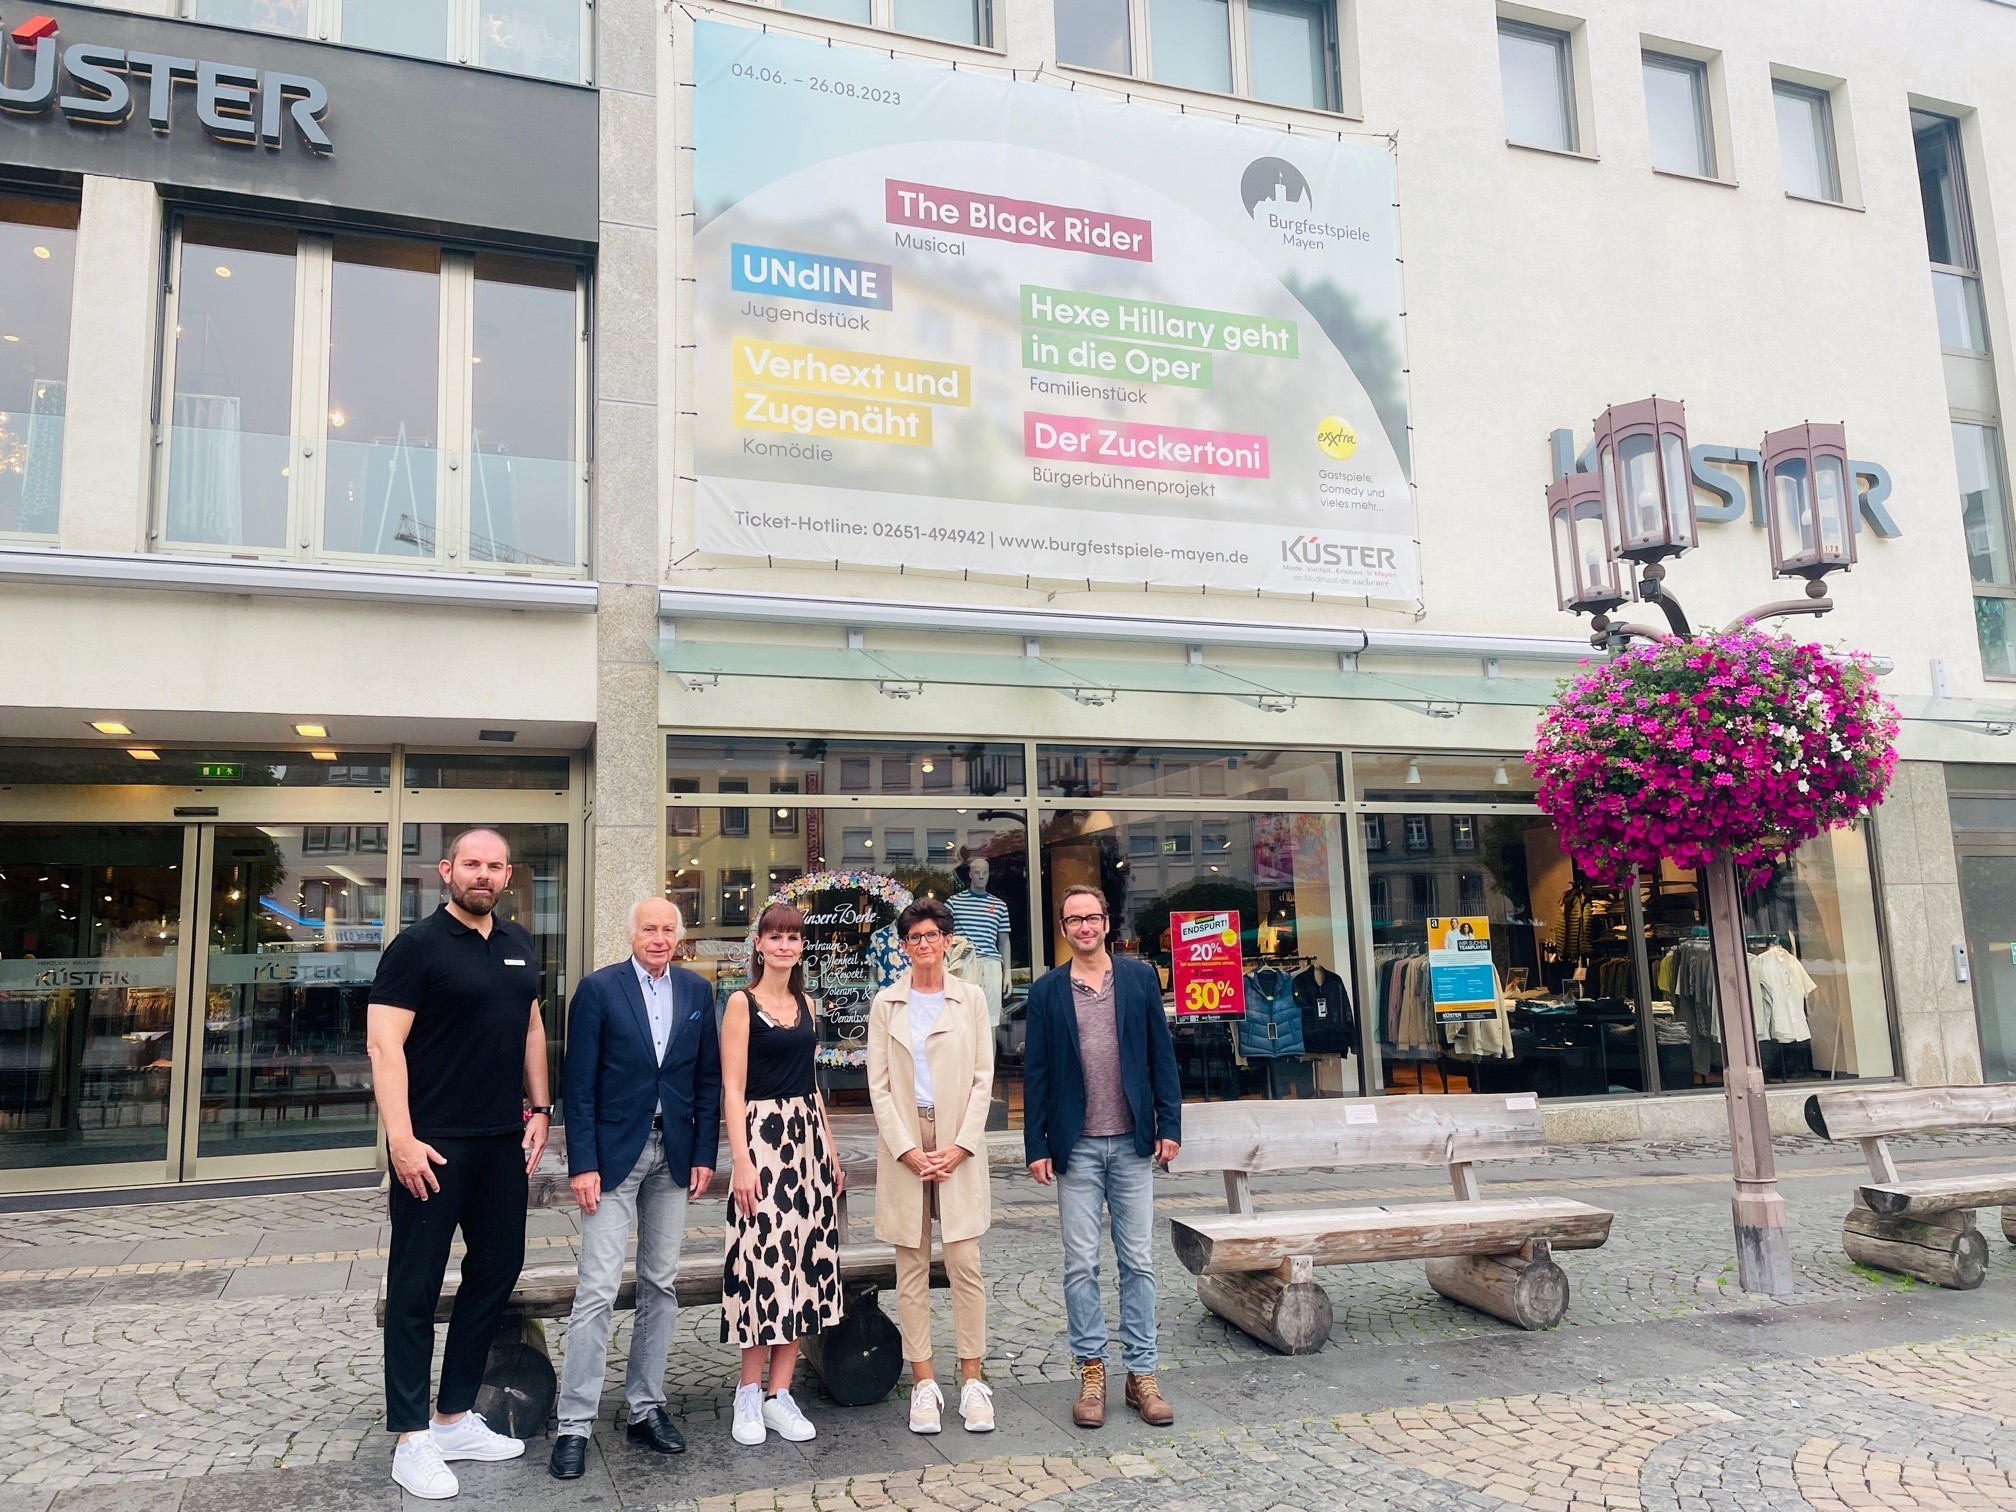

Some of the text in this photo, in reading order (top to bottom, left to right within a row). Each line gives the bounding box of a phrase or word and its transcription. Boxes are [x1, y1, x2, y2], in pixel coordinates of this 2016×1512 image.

[731, 63, 787, 85] 04.06.
[808, 76, 902, 106] 26.08.2023
[897, 190, 1144, 253] The Black Rider
[1268, 213, 1371, 242] Burgfestspiele
[894, 231, 965, 257] Musical
[1282, 233, 1325, 250] Mayen
[742, 253, 878, 300] UNdINE
[740, 300, 871, 332] Jugendstück
[1030, 292, 1290, 352] Hexe Hillary geht
[743, 345, 959, 399] Verhext und
[1031, 334, 1202, 383] in die Oper
[1029, 375, 1148, 405] Familienstück
[743, 392, 921, 438] Zugenäht
[742, 437, 834, 462] Komödie
[1034, 421, 1261, 470] Der Zuckertoni
[1317, 427, 1357, 447] exxtra
[1032, 466, 1217, 498] Bürgerbühnenprojekt
[1318, 469, 1374, 484] Gastspiele,
[1319, 483, 1386, 498] Comedy und
[1320, 498, 1384, 512] vieles mehr...
[734, 510, 868, 536] Ticket-Hotline:
[872, 522, 986, 545] 02651-494942
[998, 535, 1250, 565] www.burgfestspiele-mayen.de
[1304, 574, 1339, 584] Modehaus
[1339, 577, 1350, 585] der
[1351, 577, 1390, 588] aachener
[1335, 568, 1365, 576] Erleben.
[1182, 920, 1228, 936] ENDSPURT!
[1190, 942, 1222, 961] 20%
[861, 984, 874, 1000] &
[1185, 980, 1235, 1011] 30%
